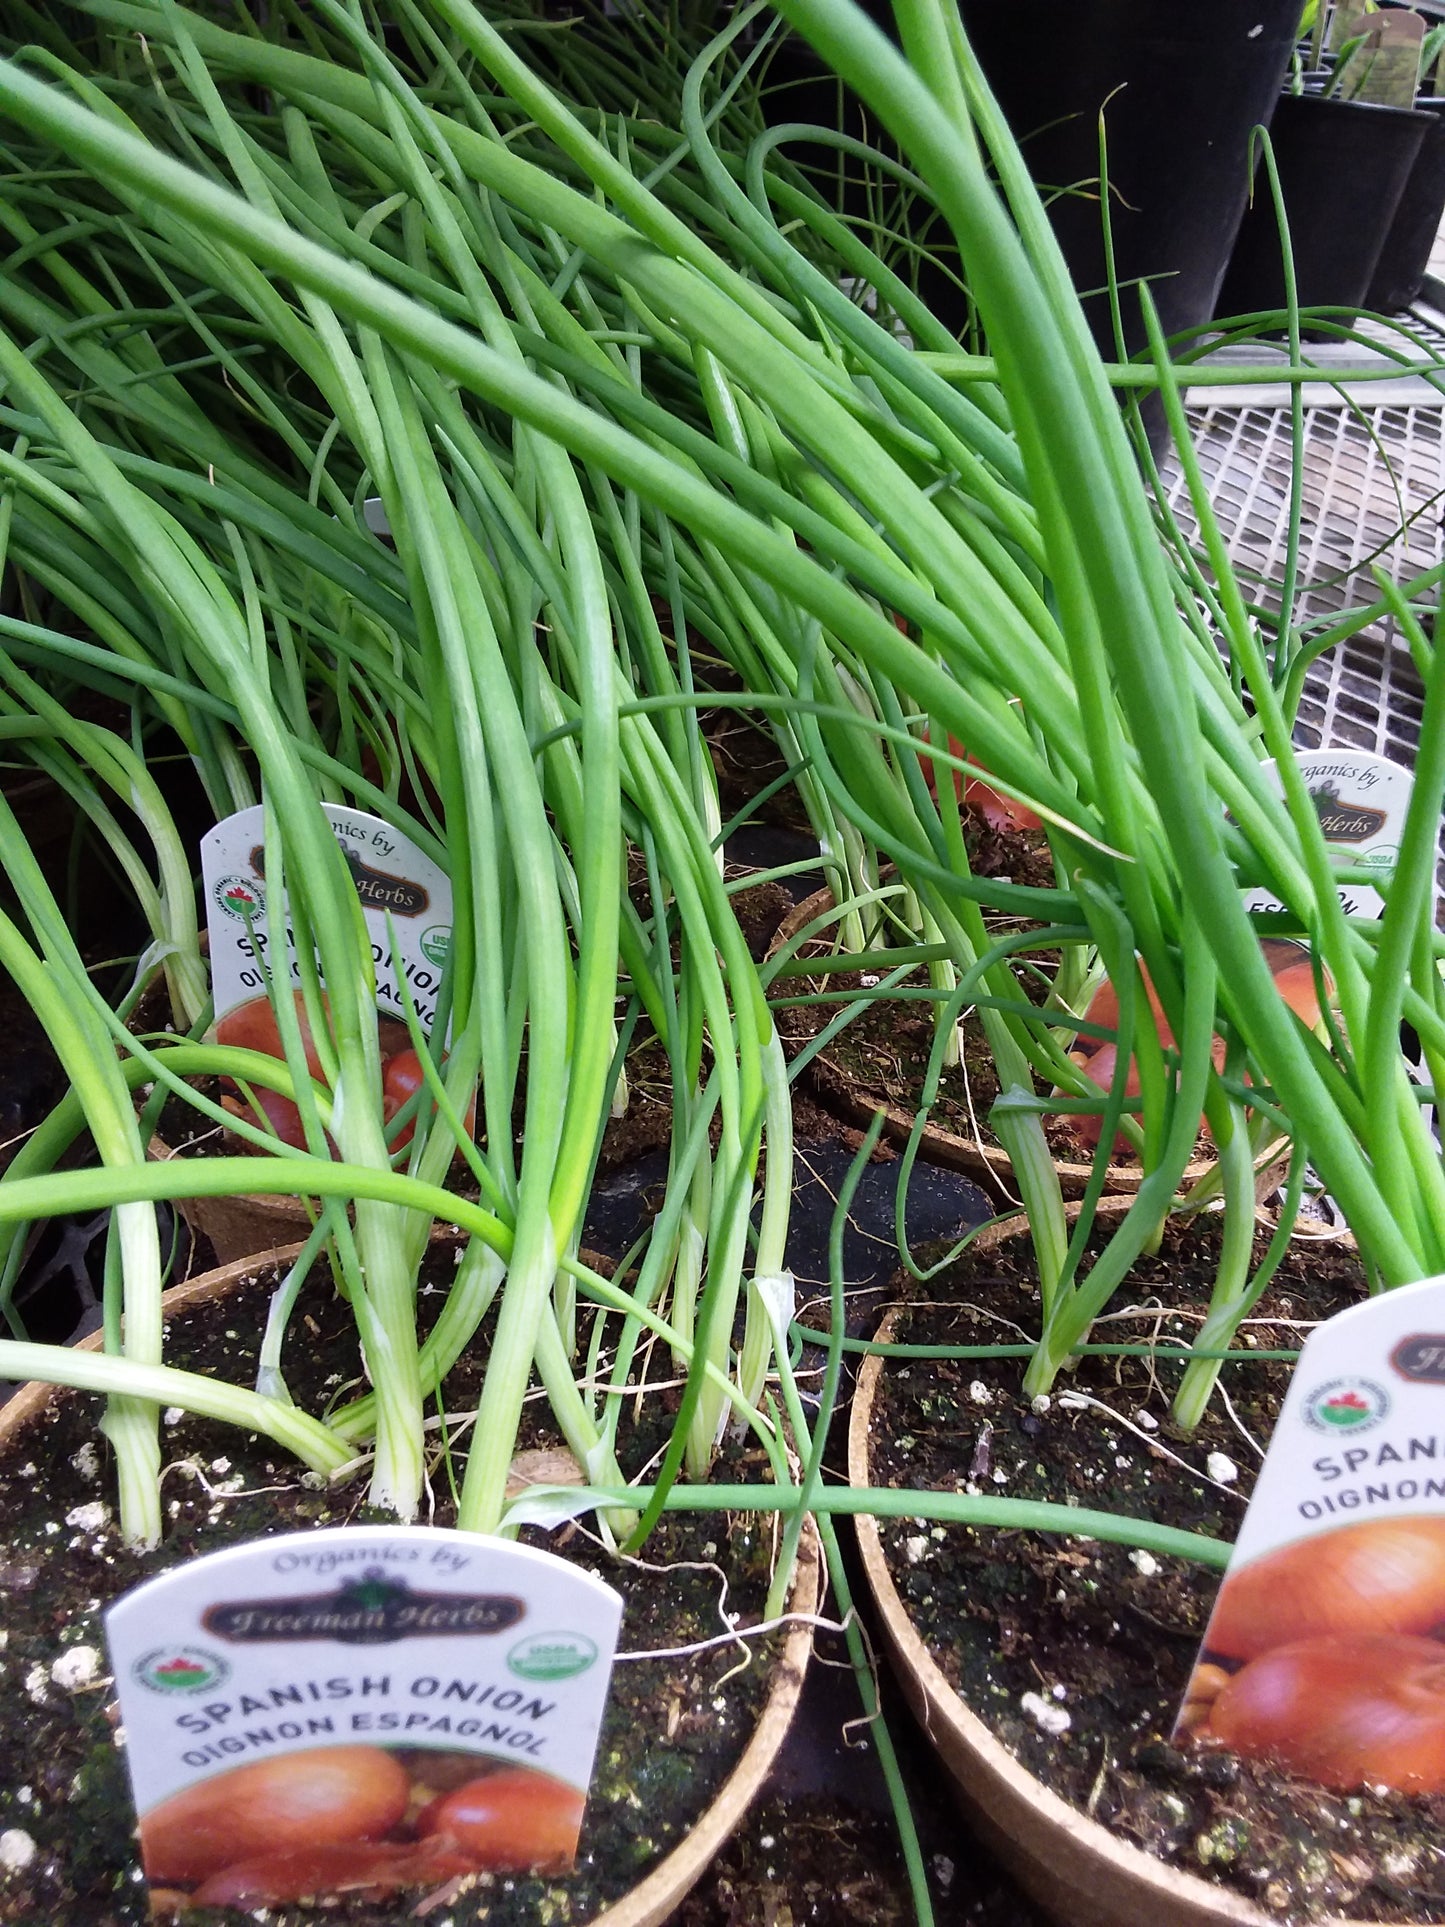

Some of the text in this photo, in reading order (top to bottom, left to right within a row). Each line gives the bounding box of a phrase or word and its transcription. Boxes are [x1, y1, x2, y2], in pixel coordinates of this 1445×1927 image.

[1300, 763, 1380, 790] rganics by
[331, 821, 396, 857] nics by
[1320, 814, 1373, 833] Herbs
[357, 880, 415, 907] Herbs
[1312, 1435, 1445, 1481] SPAN
[272, 1541, 473, 1576] Organics by
[230, 1600, 499, 1634] Freeman Herbs
[175, 1676, 557, 1735] SPANISH ONION
[181, 1711, 548, 1768] OIGNON ESPAGNOL
